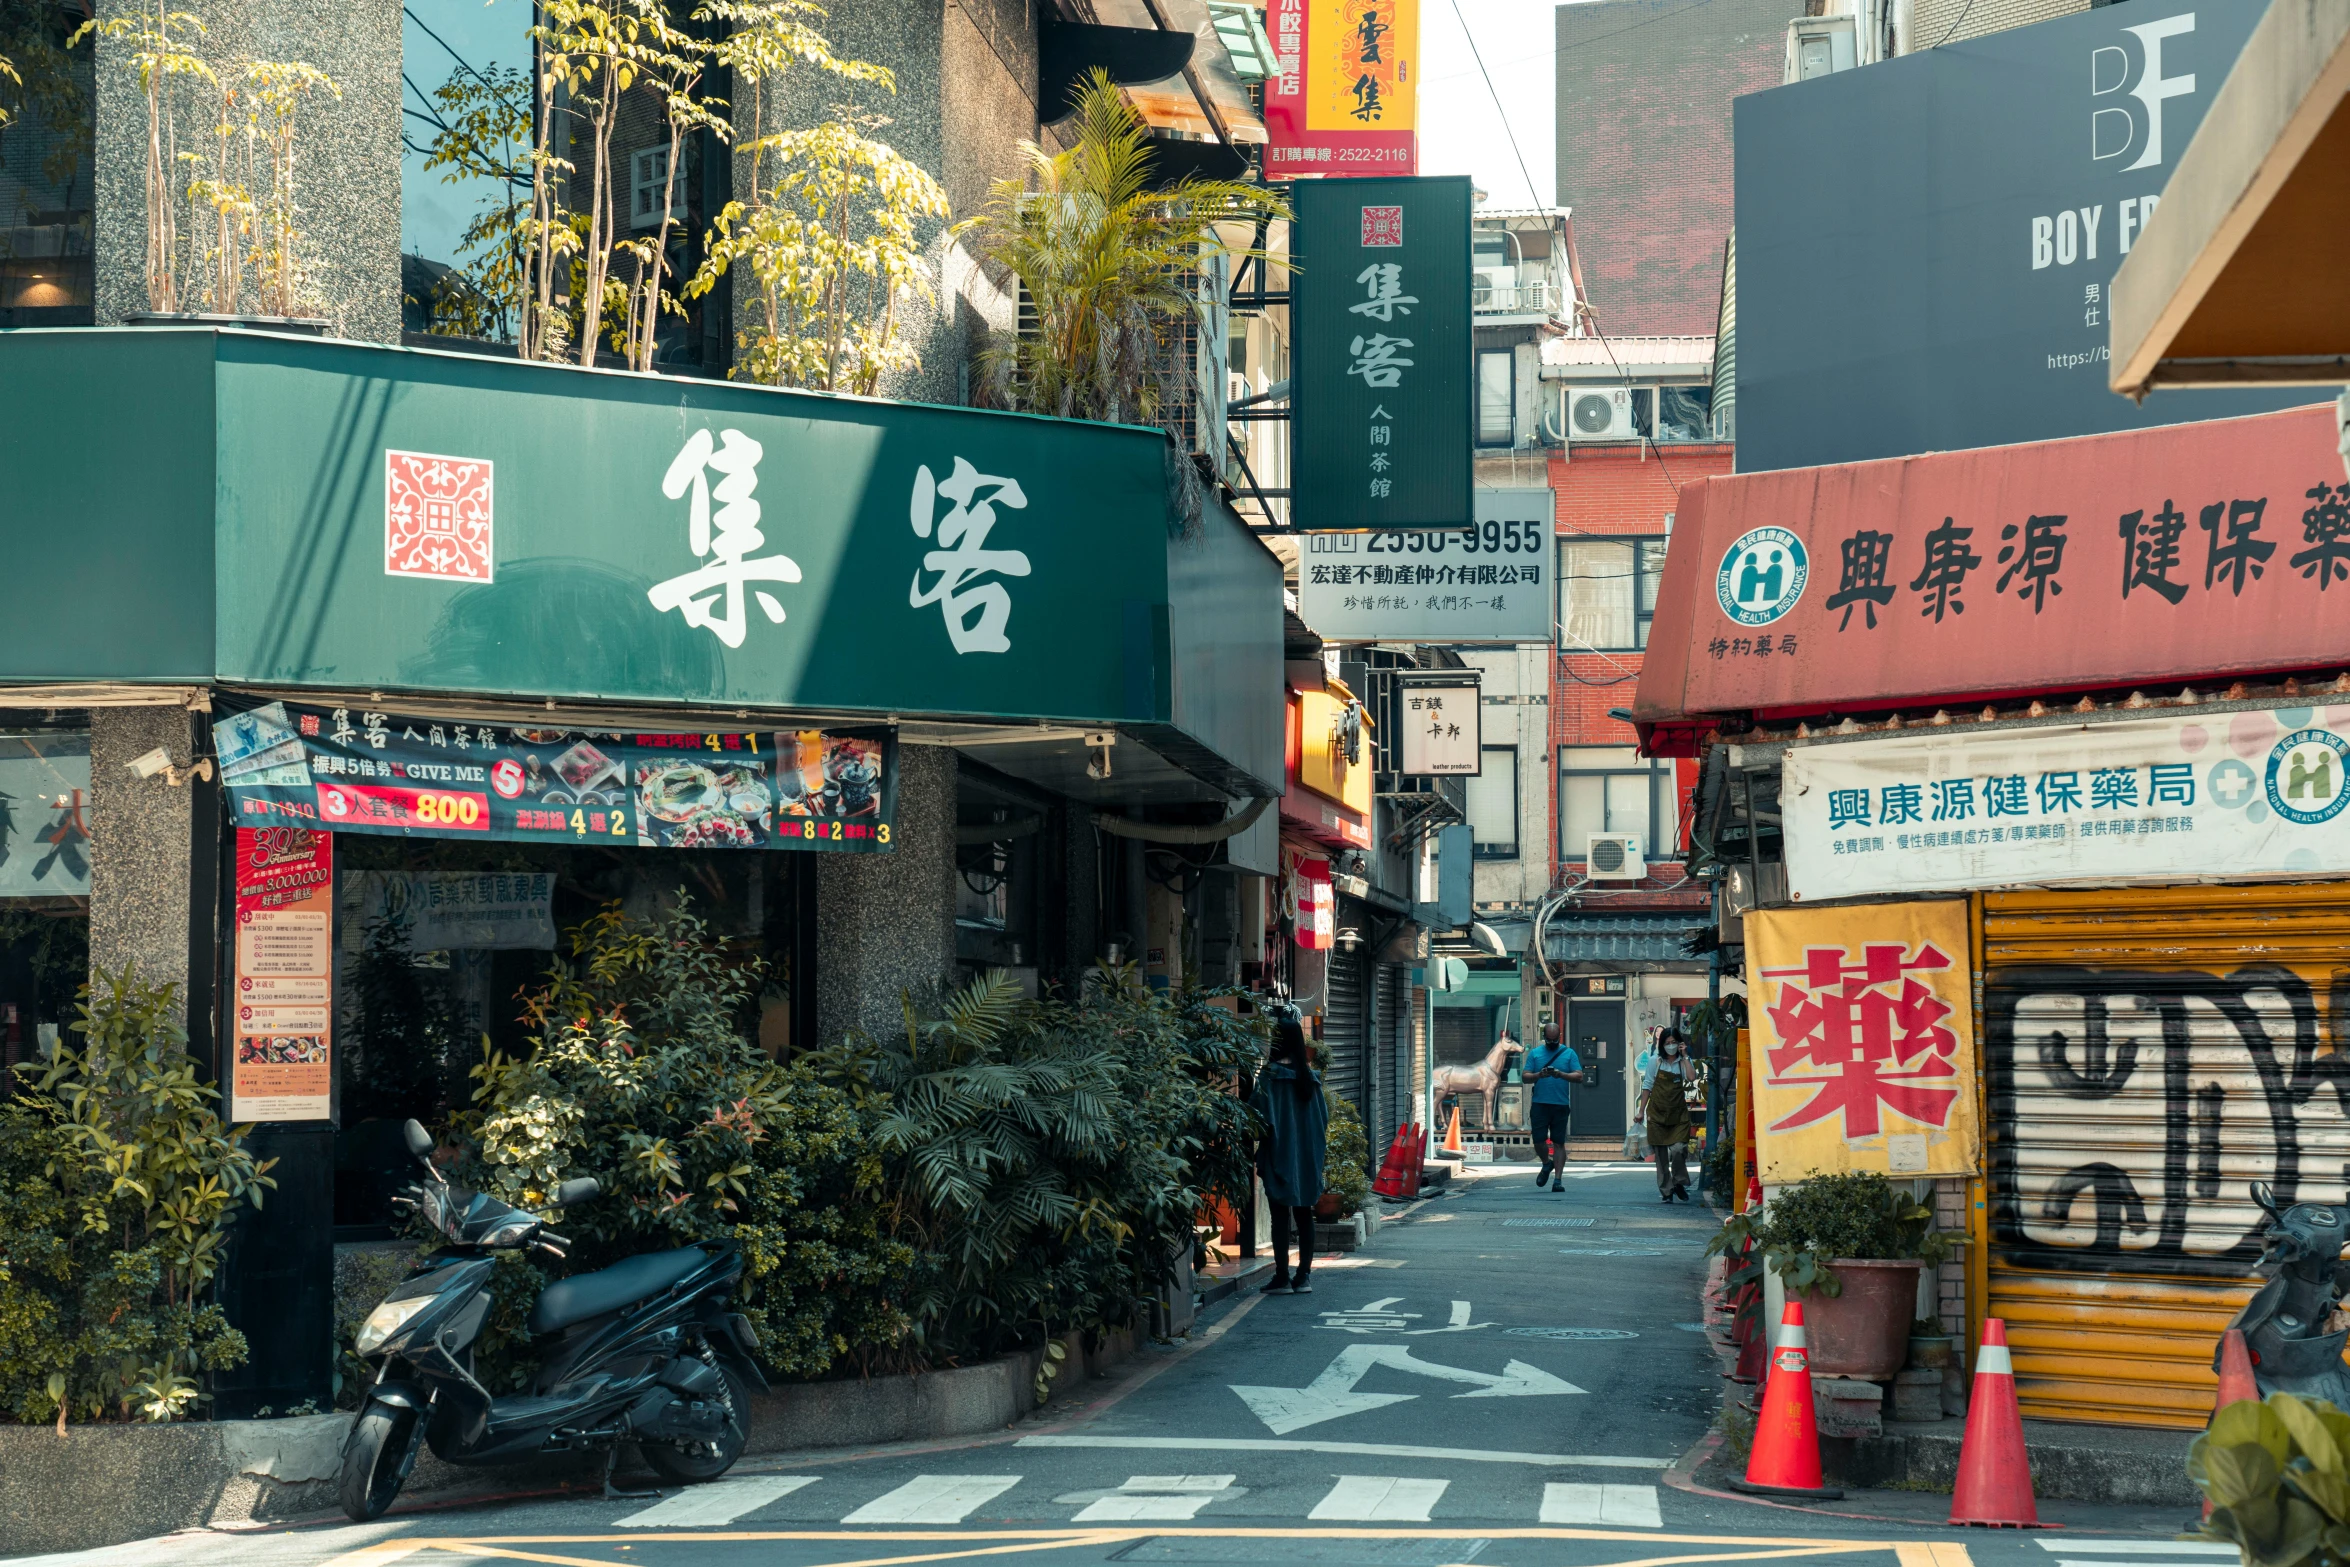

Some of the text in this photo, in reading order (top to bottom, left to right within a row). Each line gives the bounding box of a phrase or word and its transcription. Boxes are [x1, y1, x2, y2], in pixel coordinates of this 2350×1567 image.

[1350, 0, 1389, 122] 雲集
[2032, 204, 2102, 271] BOY
[2084, 284, 2100, 328] 男仕
[1347, 263, 1419, 387] 集客
[1370, 404, 1393, 498] 人間茶館
[647, 428, 1031, 655] 集客
[1367, 520, 1541, 553] 2550-9955
[1736, 530, 1795, 551] 全民健康保險
[1310, 564, 1541, 585] 宏達不動產仲介有限公司
[1826, 516, 2068, 633] 興康源
[1719, 564, 1806, 623] NATIONAL HEALTH INSURANCE
[1708, 634, 1798, 660] 特約藥局
[329, 708, 498, 750] 集客 人間茶館
[1427, 723, 1460, 741] 卡邦
[1431, 711, 1439, 720] &
[406, 764, 451, 780] GIVE
[456, 767, 485, 781] ME
[495, 762, 522, 795] 5
[1450, 763, 1473, 771] products
[415, 794, 479, 824] 800
[1828, 763, 2197, 831] 興康源健保藥局
[2267, 779, 2288, 816] NATIONAL
[2291, 811, 2323, 822] HEALTH
[270, 850, 316, 866] Anniversary
[1833, 836, 1884, 855] 免費調劑
[265, 868, 328, 892] 3,000,000
[1758, 940, 1963, 1139] 藥
